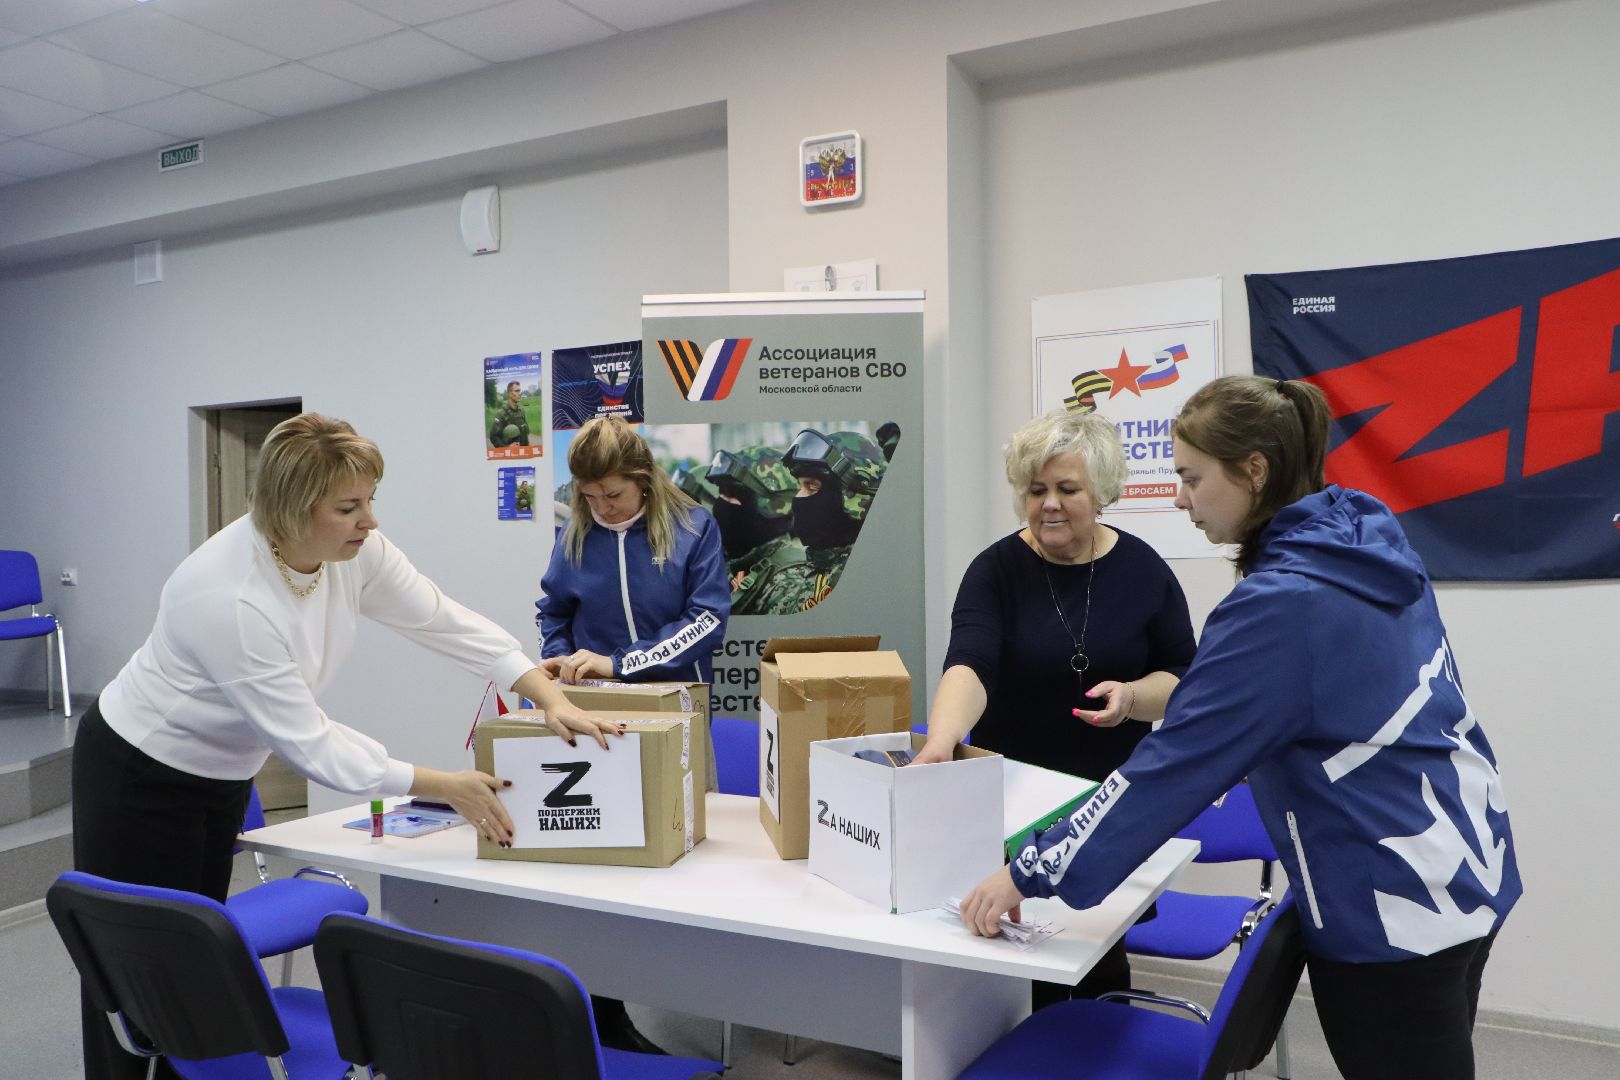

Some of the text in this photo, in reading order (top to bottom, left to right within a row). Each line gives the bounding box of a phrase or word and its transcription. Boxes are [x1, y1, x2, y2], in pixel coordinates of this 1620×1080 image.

[1292, 296, 1336, 306] ЕДИНАЯ
[1292, 304, 1336, 315] РОССИЯ
[758, 345, 877, 363] Ассоциация
[592, 360, 631, 374] УСПЕХ
[758, 362, 908, 383] ветеранов СВО
[758, 384, 862, 394] Московской области
[1115, 419, 1176, 438] ТНИ
[1122, 440, 1174, 460] ЕСТВ
[1158, 466, 1177, 475] Пру
[1128, 486, 1174, 496] БРОСАЕМ
[540, 761, 593, 808] Z
[537, 808, 601, 818] ПОДДЕРЖИМ
[538, 816, 601, 831] НАШИХ!
[839, 816, 881, 851] НАШИХ
